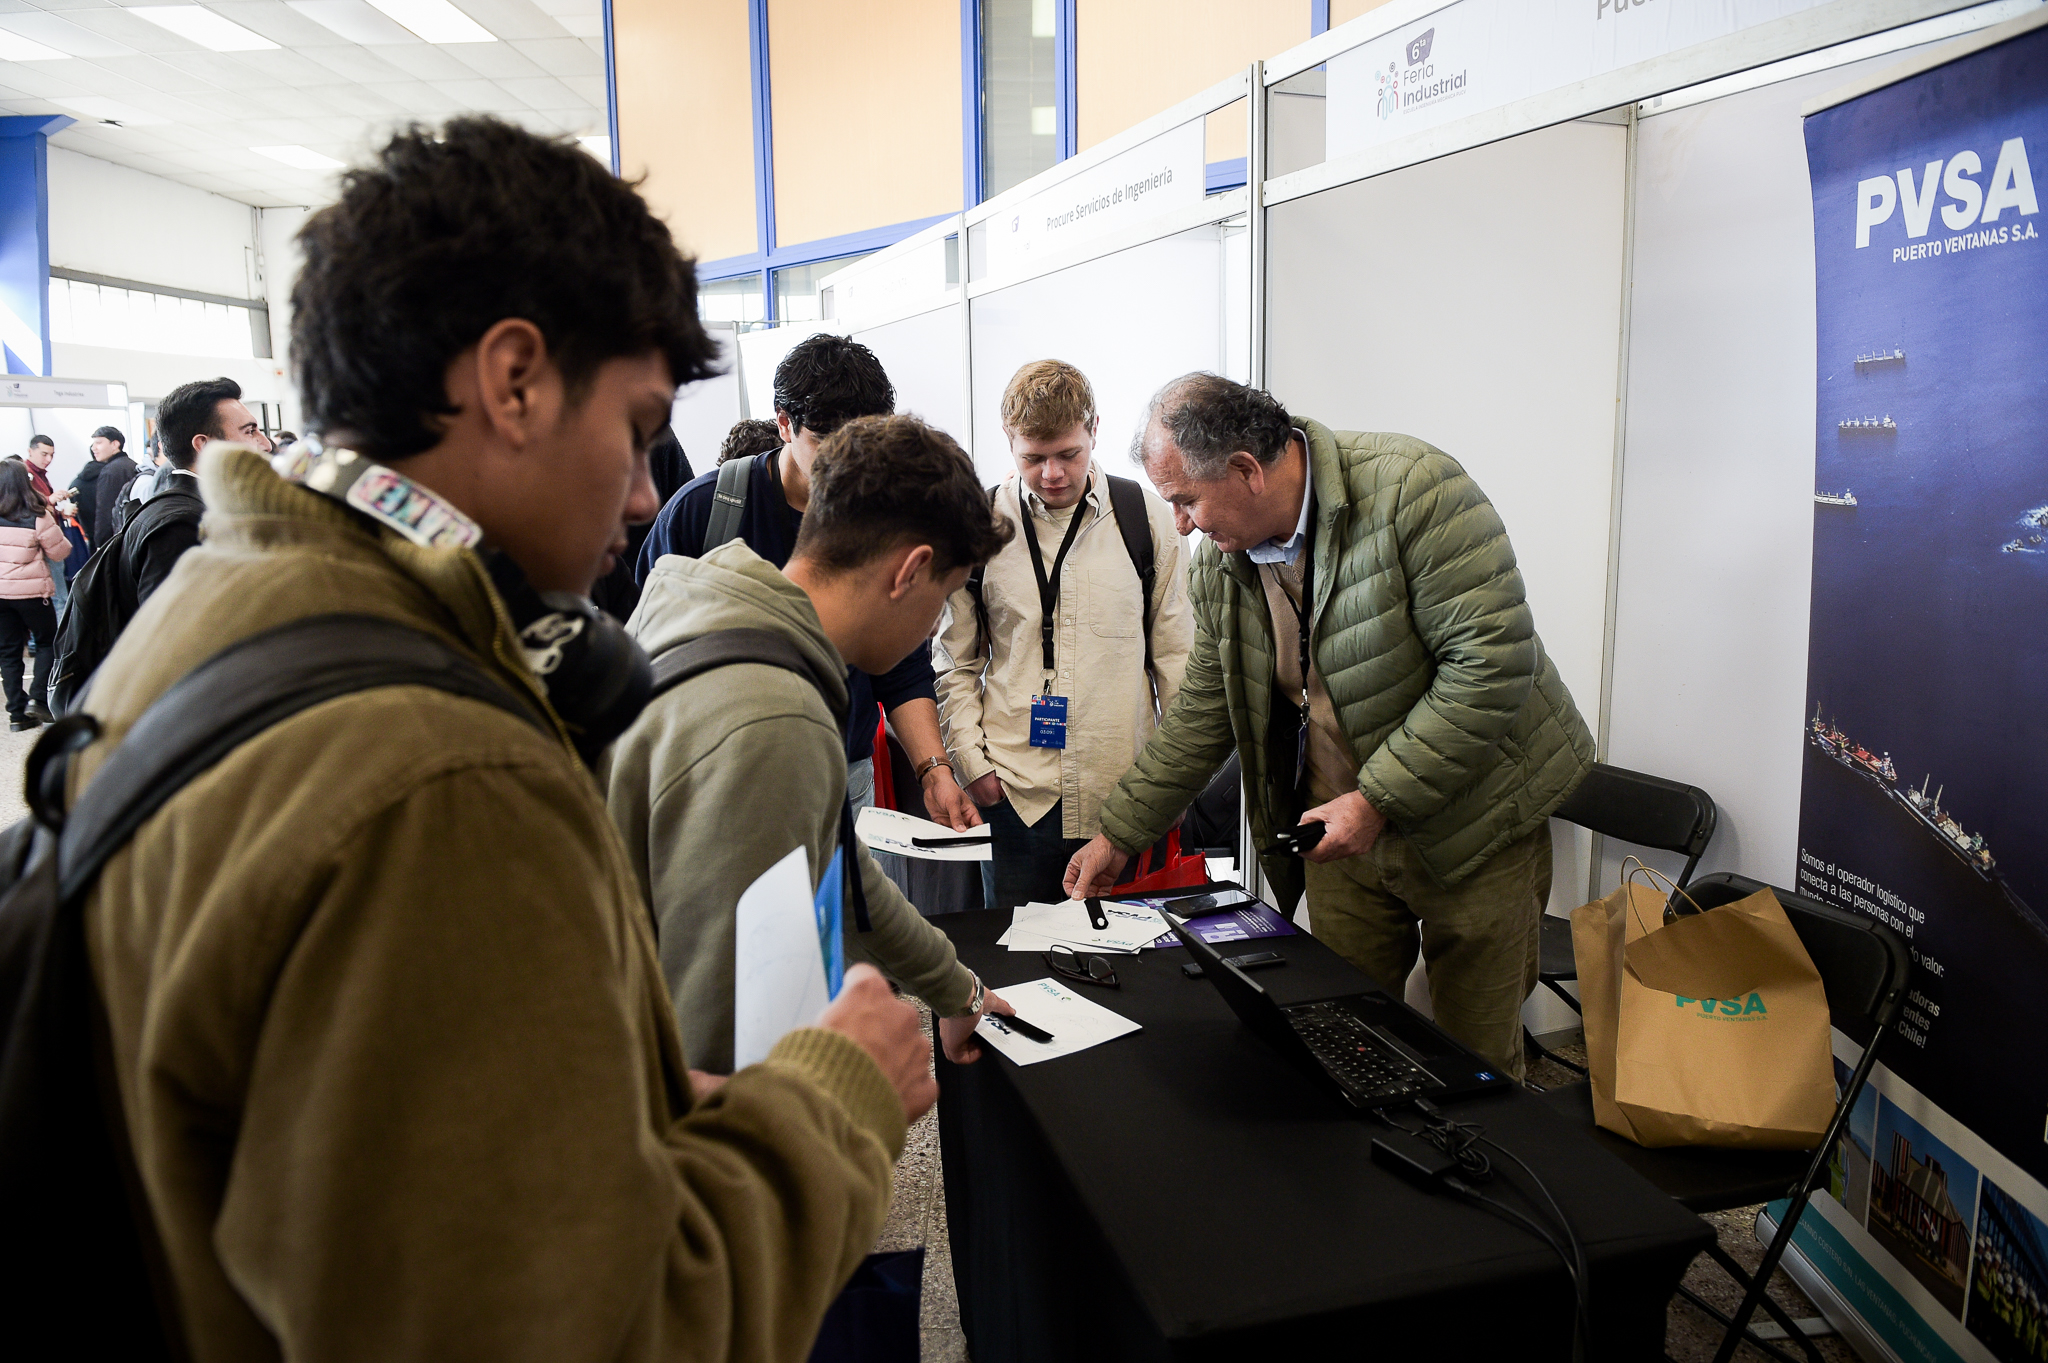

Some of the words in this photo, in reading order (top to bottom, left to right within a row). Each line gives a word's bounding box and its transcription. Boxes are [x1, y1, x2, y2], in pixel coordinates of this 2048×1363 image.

[1403, 63, 1434, 87] Feria
[1403, 68, 1467, 107] Industrial
[1046, 210, 1075, 232] Procure
[1075, 194, 1110, 220] Servicios
[1112, 187, 1123, 205] de
[1125, 166, 1173, 202] Ingeniería
[1855, 136, 2040, 250] PVSA
[1892, 240, 1942, 263] PUERTO
[1944, 226, 2009, 254] VENTANAS
[2011, 221, 2039, 242] S.A.
[1800, 868, 1828, 892] conecta
[1830, 884, 1836, 896] a
[1839, 884, 1852, 902] las
[1853, 894, 1889, 923] personas
[1890, 915, 1904, 933] con
[1905, 924, 1914, 939] el
[1801, 847, 1825, 872] Somos
[1827, 863, 1836, 876] el
[1837, 868, 1876, 895] operador
[1908, 906, 1925, 924] que
[1037, 982, 1061, 997] PVSA
[1696, 1012, 1721, 1020] PUERTO
[1898, 1020, 1927, 1049] Chile!
